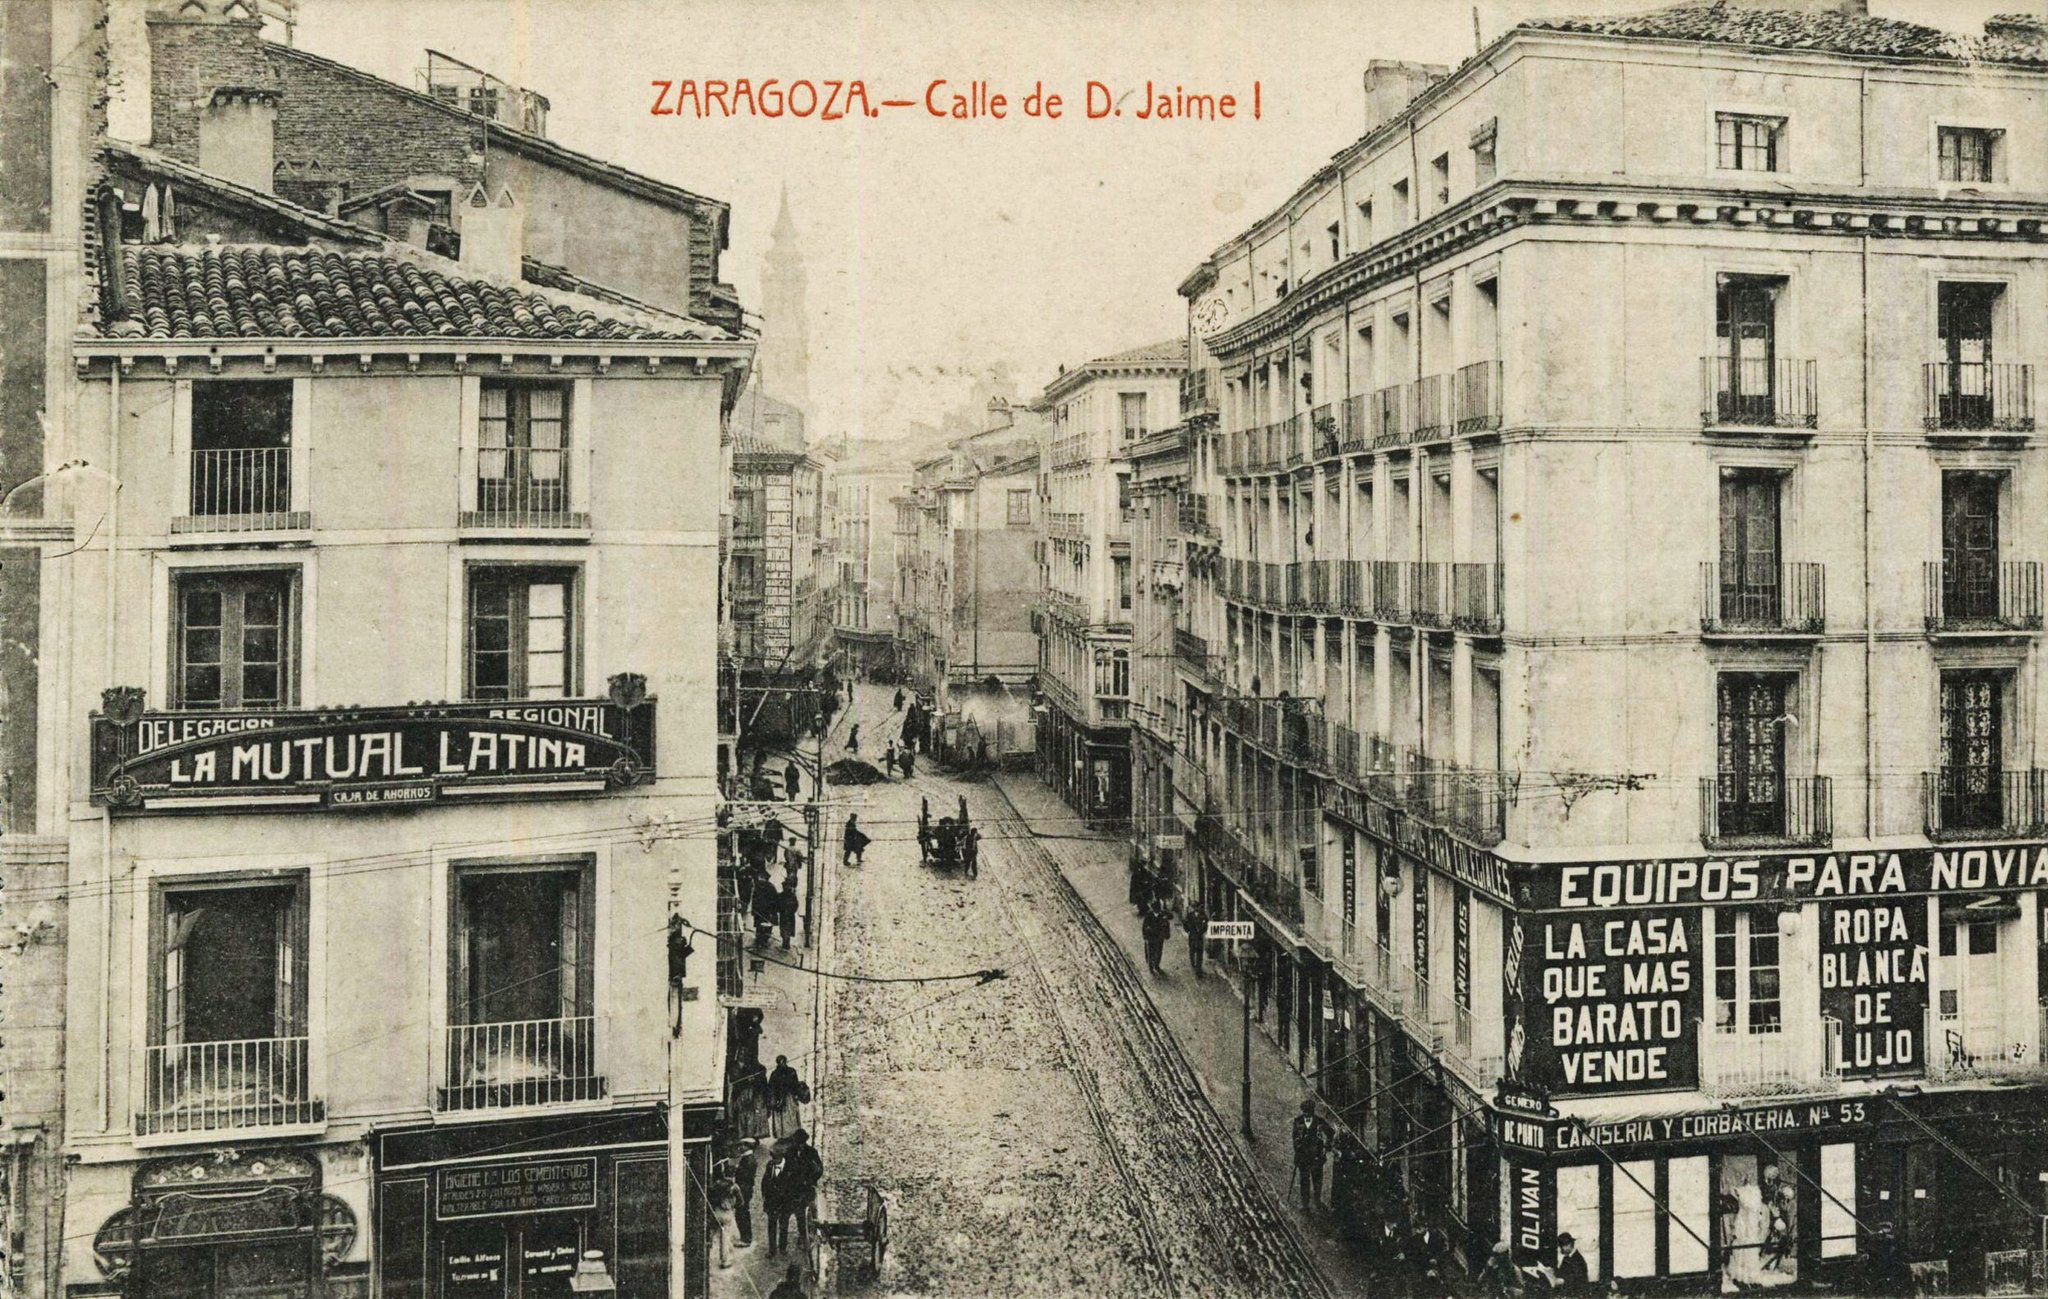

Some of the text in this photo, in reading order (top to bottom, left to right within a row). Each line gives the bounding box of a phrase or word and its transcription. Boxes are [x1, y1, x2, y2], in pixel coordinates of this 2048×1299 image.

[139, 707, 612, 755] DELEGACION REGIONAL
[171, 731, 586, 783] LA MUTUAL LATINA
[334, 787, 431, 803] CAJA DE AHORROS
[1559, 859, 1760, 907] EQUIPOS
[1786, 853, 1907, 896] PARA
[1210, 925, 1252, 936] IMPRENTA
[1545, 917, 1689, 960] LA CASA
[1834, 906, 1909, 945] ROPA
[1543, 960, 1690, 1004] QUE MAS
[1822, 943, 1926, 989] BLANCA
[1552, 999, 1682, 1047] BARATO
[1854, 991, 1892, 1025] DE
[1561, 1046, 1668, 1084] VENDE
[1836, 1029, 1912, 1070] LUJO
[1505, 1095, 1542, 1111] GENERO
[1504, 1120, 1544, 1148] DE PUNTO
[1557, 1121, 1654, 1149] CAMISERIA
[1662, 1118, 1673, 1139] Y
[1840, 1103, 1865, 1123] 53
[501, 1168, 521, 1184] LOS
[1521, 1168, 1540, 1250] OLIVAN
